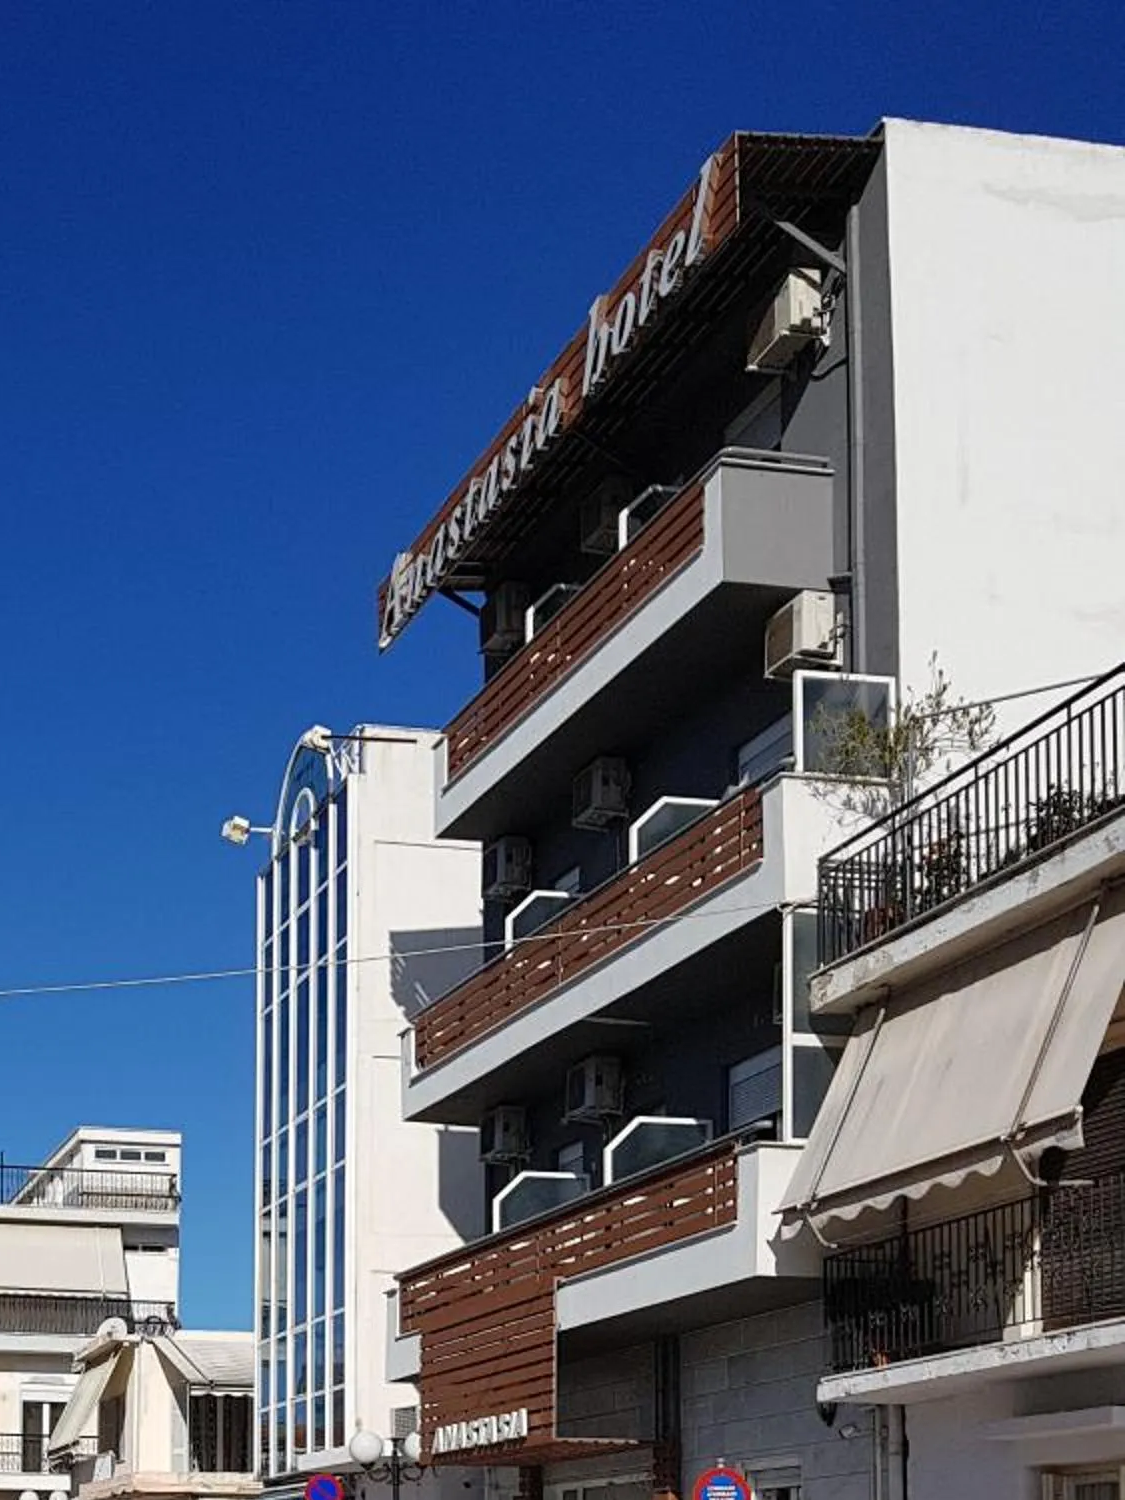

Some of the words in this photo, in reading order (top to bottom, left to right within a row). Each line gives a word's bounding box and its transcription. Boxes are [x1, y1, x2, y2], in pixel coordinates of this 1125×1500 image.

[378, 378, 564, 650] Anastasia
[582, 153, 716, 398] hotel
[431, 1407, 528, 1455] ANASTASIA
